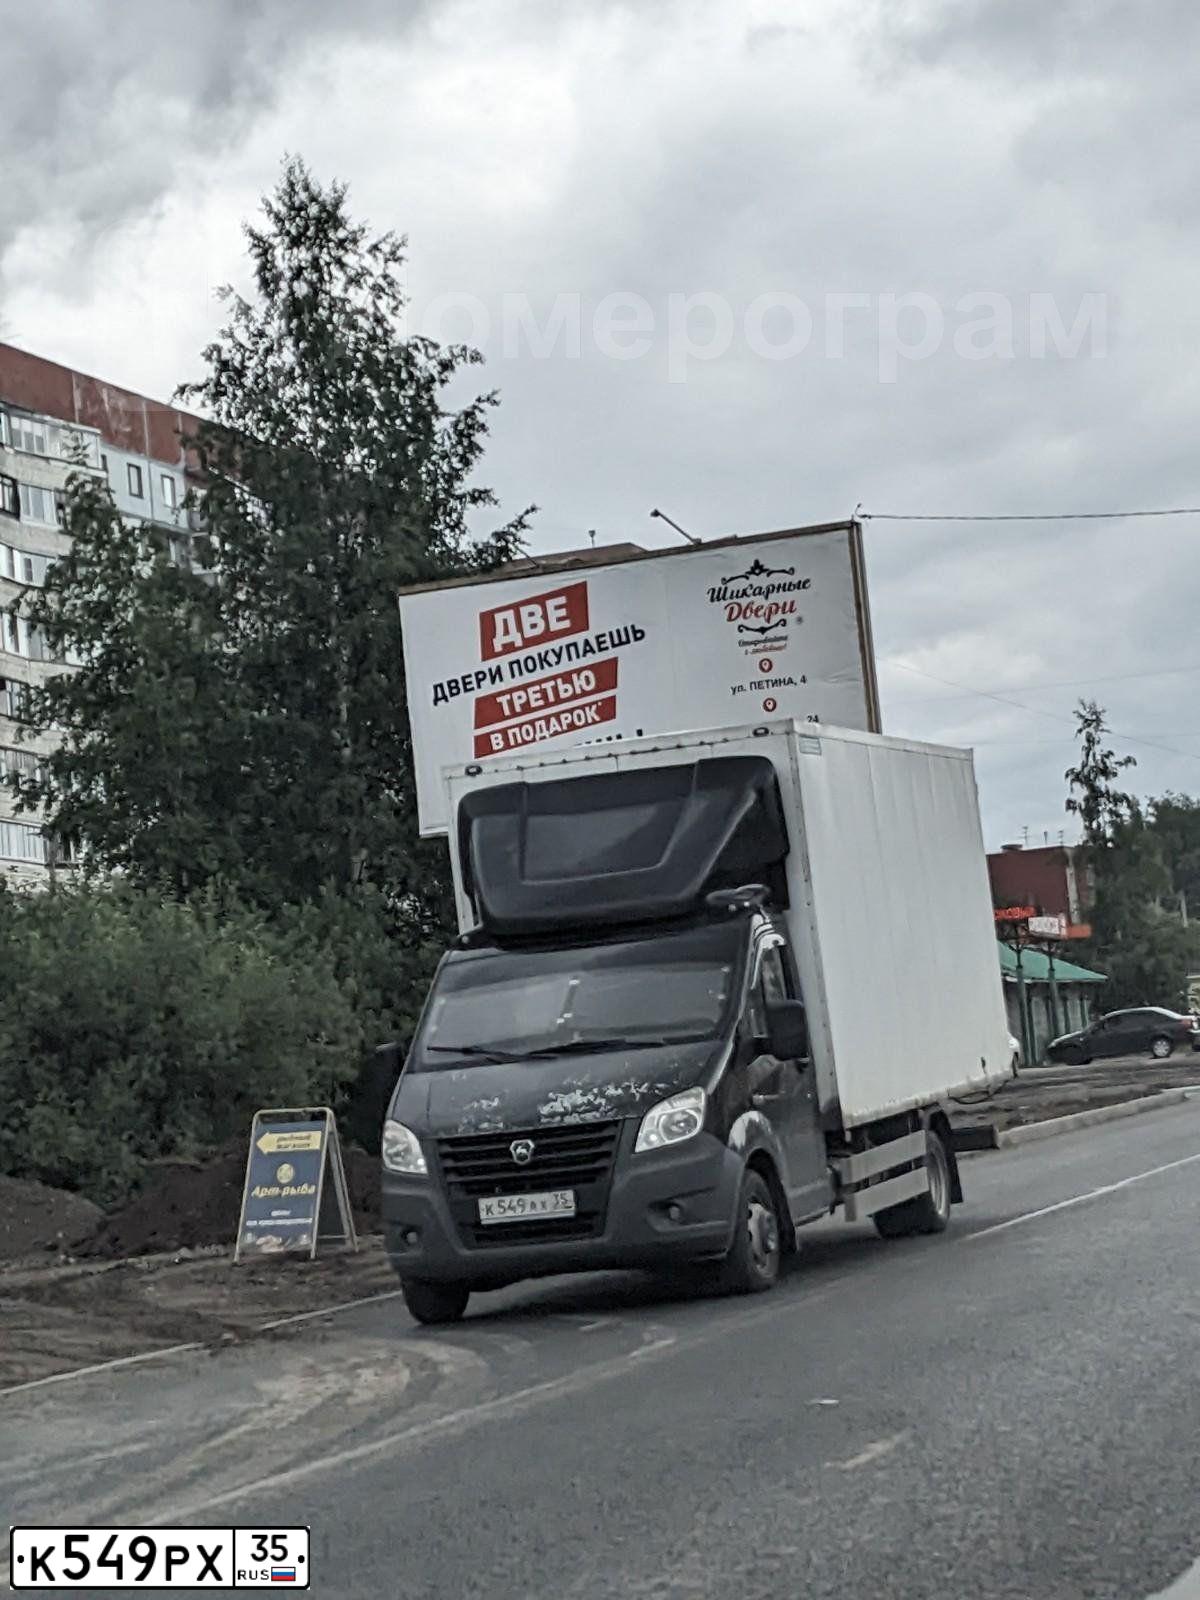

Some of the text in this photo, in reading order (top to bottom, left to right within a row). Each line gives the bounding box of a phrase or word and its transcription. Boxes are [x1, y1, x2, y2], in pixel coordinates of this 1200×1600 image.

[707, 578, 812, 603] Шикарные
[492, 596, 571, 653] ДВЕ
[724, 600, 797, 624] Двери
[432, 624, 645, 706] ДВЕРИ ПОКУПАЕШЬ
[496, 669, 596, 716] ТРЕТЬЮ
[730, 675, 807, 695] ул. ПЕТИНА, 4
[490, 733, 503, 751] В
